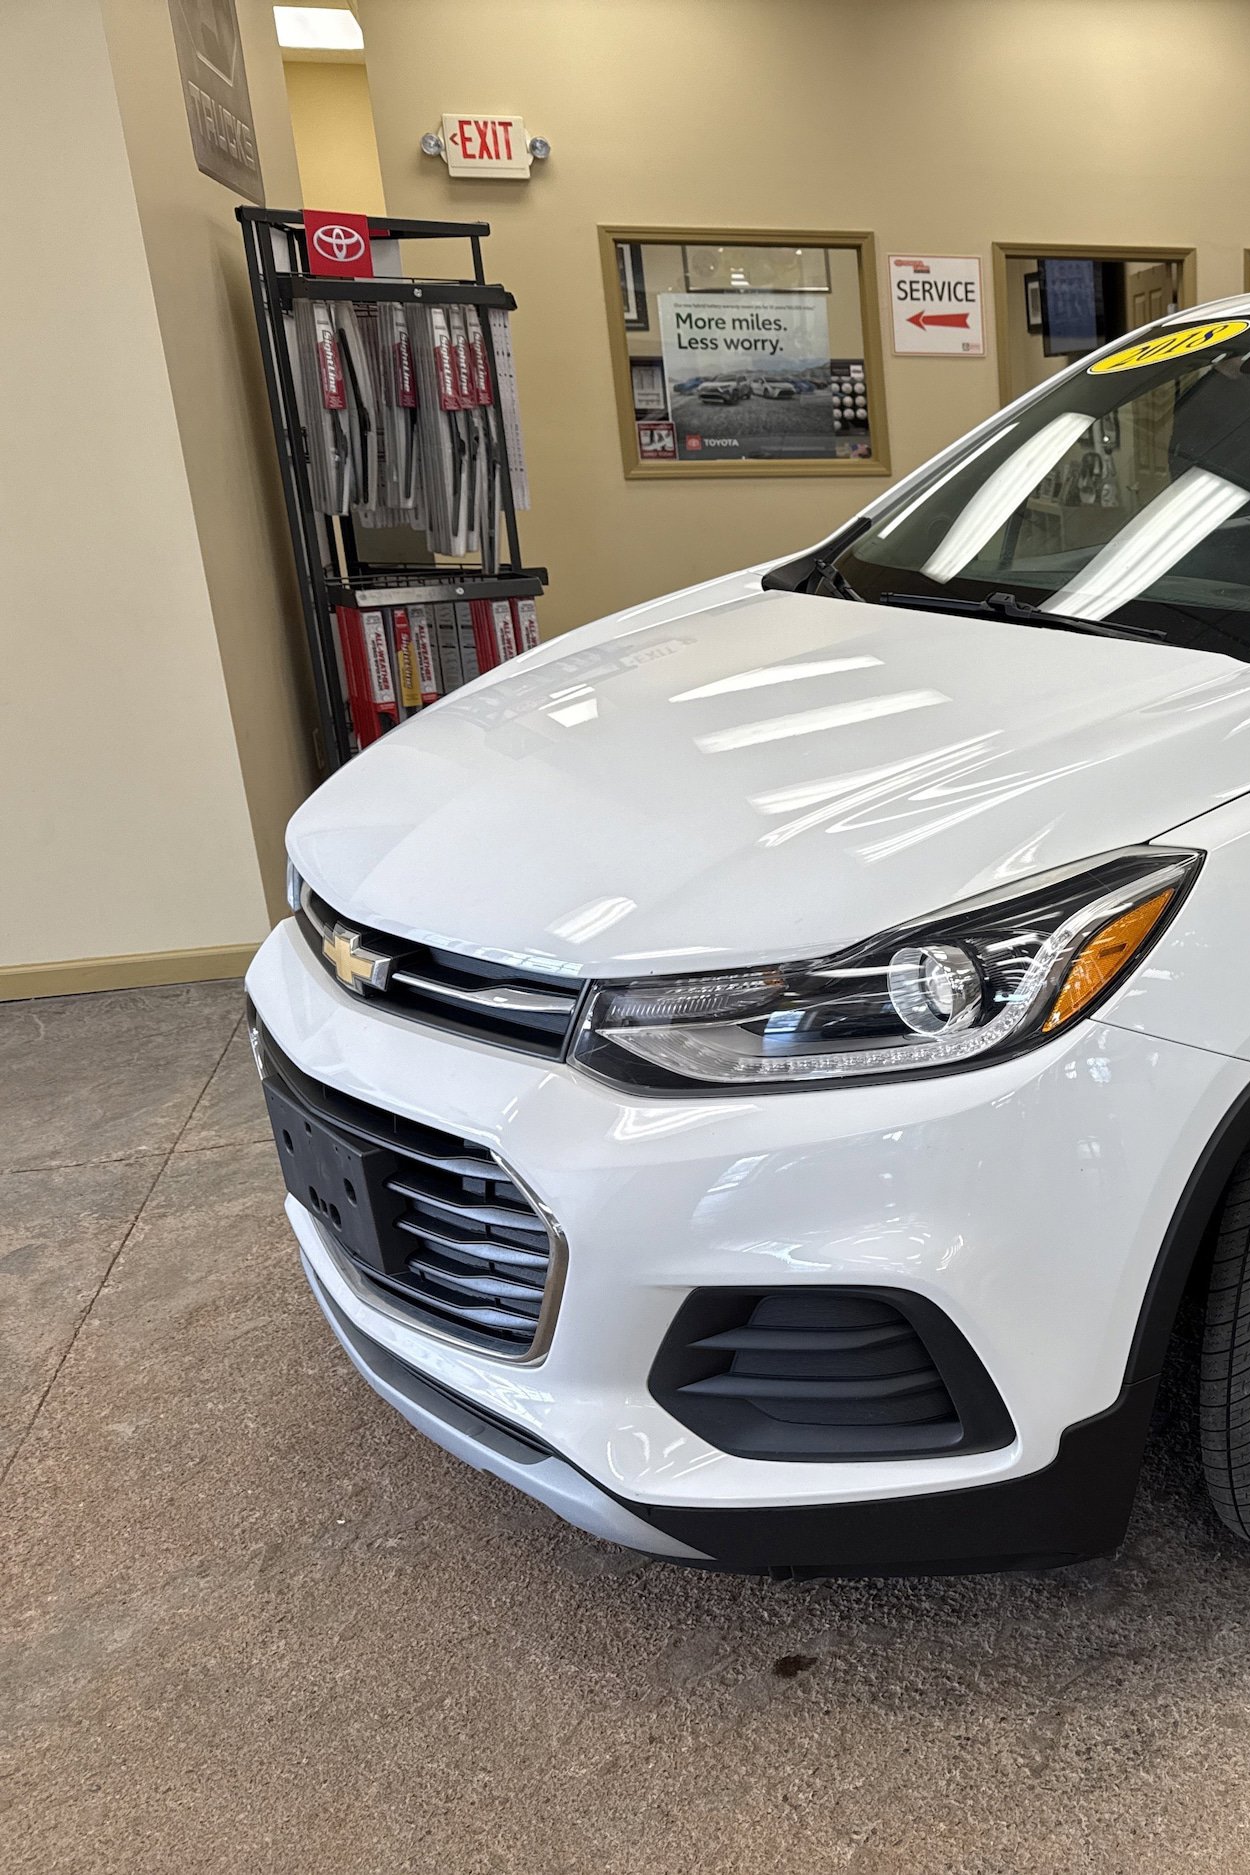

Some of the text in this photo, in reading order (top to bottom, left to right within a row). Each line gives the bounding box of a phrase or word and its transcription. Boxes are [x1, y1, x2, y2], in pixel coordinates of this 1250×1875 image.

[188, 80, 256, 171] TRUCKS
[458, 120, 513, 161] EXIT
[896, 279, 976, 303] SERVICE
[674, 312, 788, 332] More miles.
[676, 332, 785, 356] Less worry.
[320, 329, 338, 394] SightLine
[439, 334, 454, 396] SightLine
[1106, 323, 1230, 370] 2018
[703, 438, 740, 447] TOYOTA
[374, 632, 390, 690] ALL-WEATHER
[418, 625, 432, 681] ALL-WEATHER
